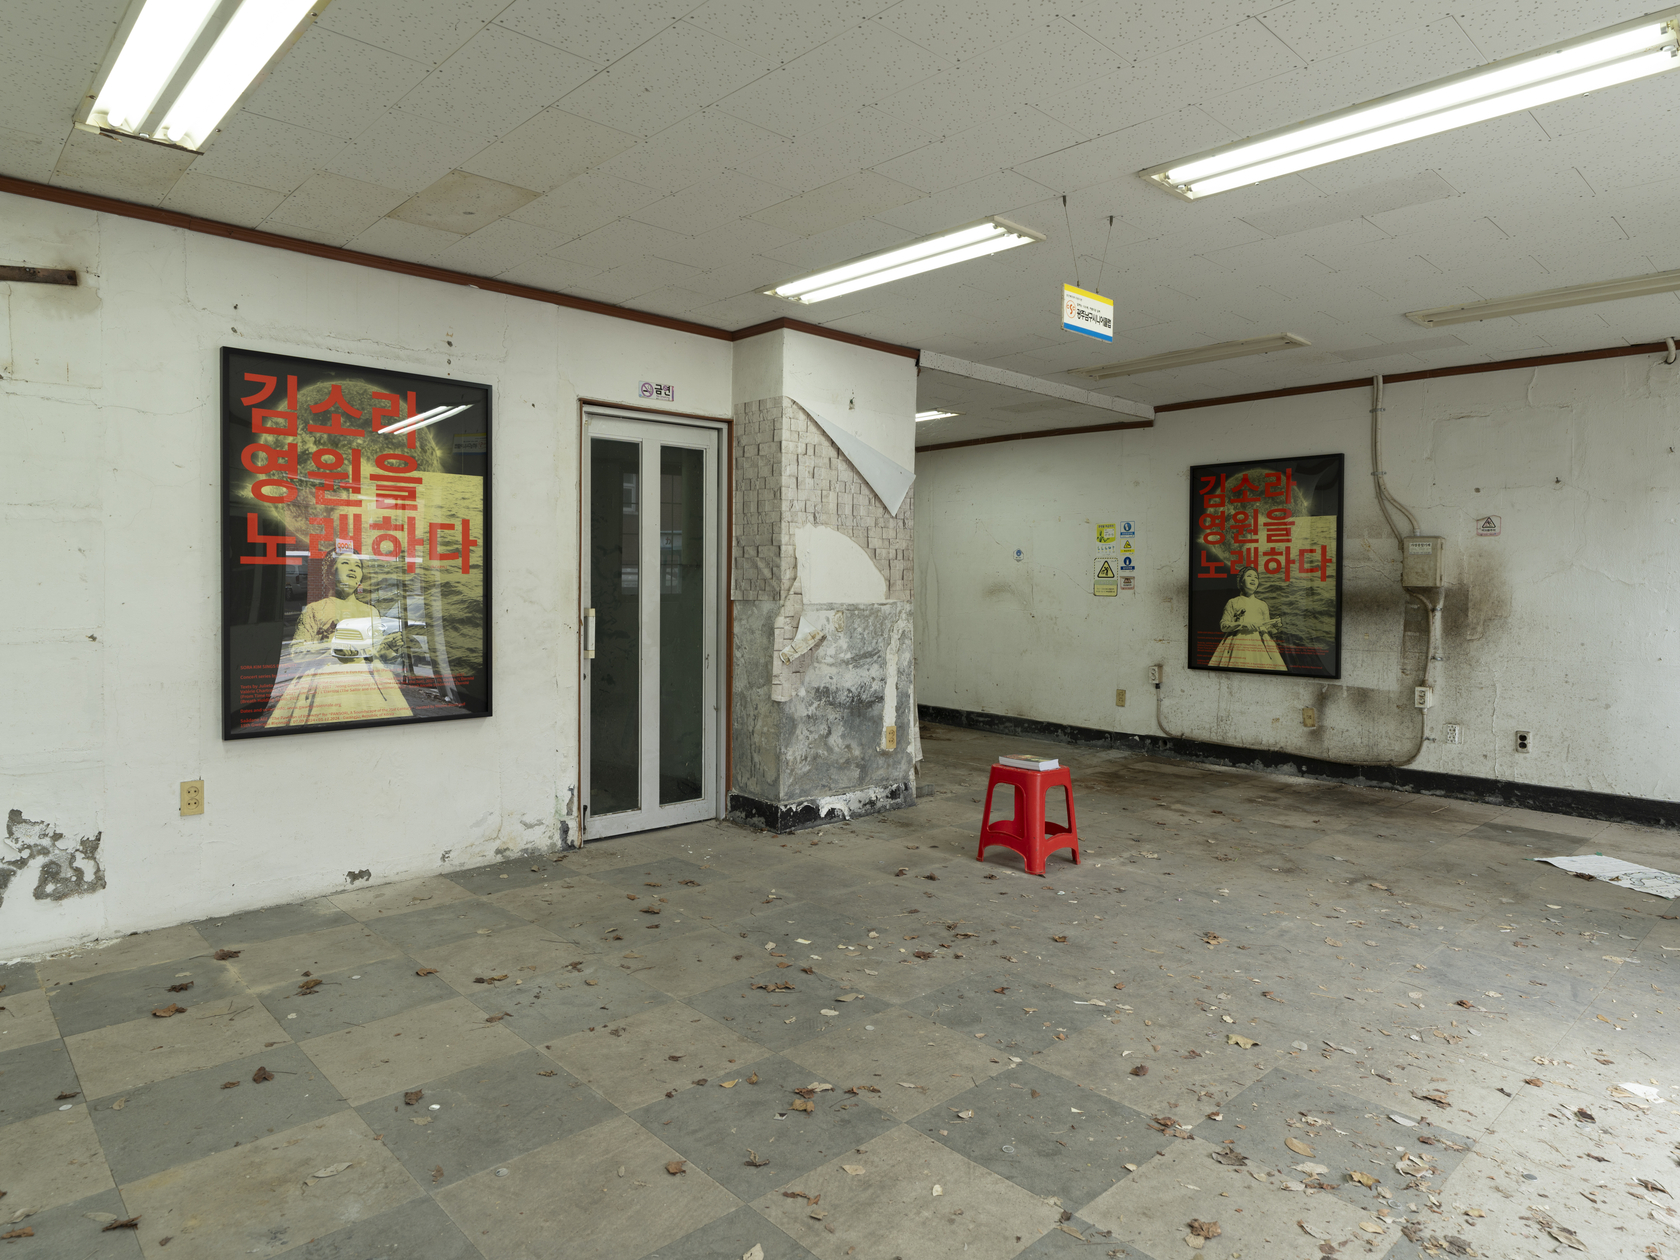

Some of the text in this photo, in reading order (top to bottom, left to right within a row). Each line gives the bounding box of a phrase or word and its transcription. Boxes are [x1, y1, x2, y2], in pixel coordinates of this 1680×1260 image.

[654, 384, 670, 396] 금연
[240, 372, 424, 449] 김소라
[240, 442, 422, 511] 영원을
[1199, 468, 1297, 508] 김소라
[240, 512, 478, 574] 노래하다
[1198, 508, 1296, 545] 영원을
[1198, 544, 1332, 582] 노래하다
